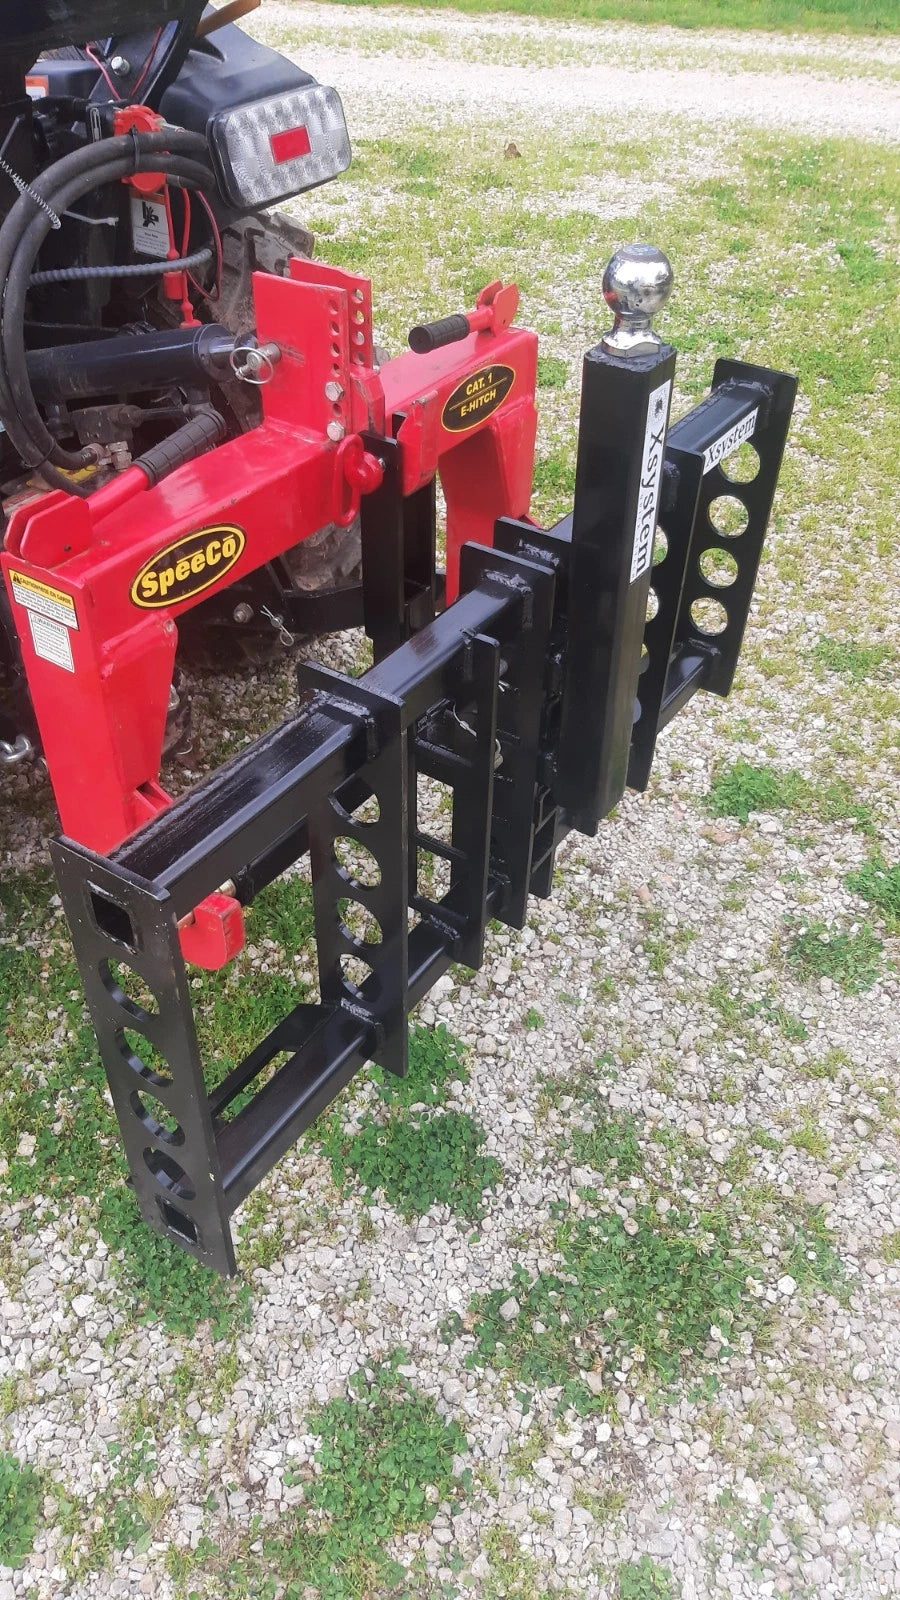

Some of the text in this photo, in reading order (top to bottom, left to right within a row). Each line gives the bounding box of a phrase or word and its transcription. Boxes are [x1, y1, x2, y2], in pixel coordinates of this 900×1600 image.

[461, 389, 497, 417] E-HITCH
[466, 372, 493, 396] CAT. 1
[705, 415, 755, 468] Xsystem
[636, 423, 665, 574] Xsystem
